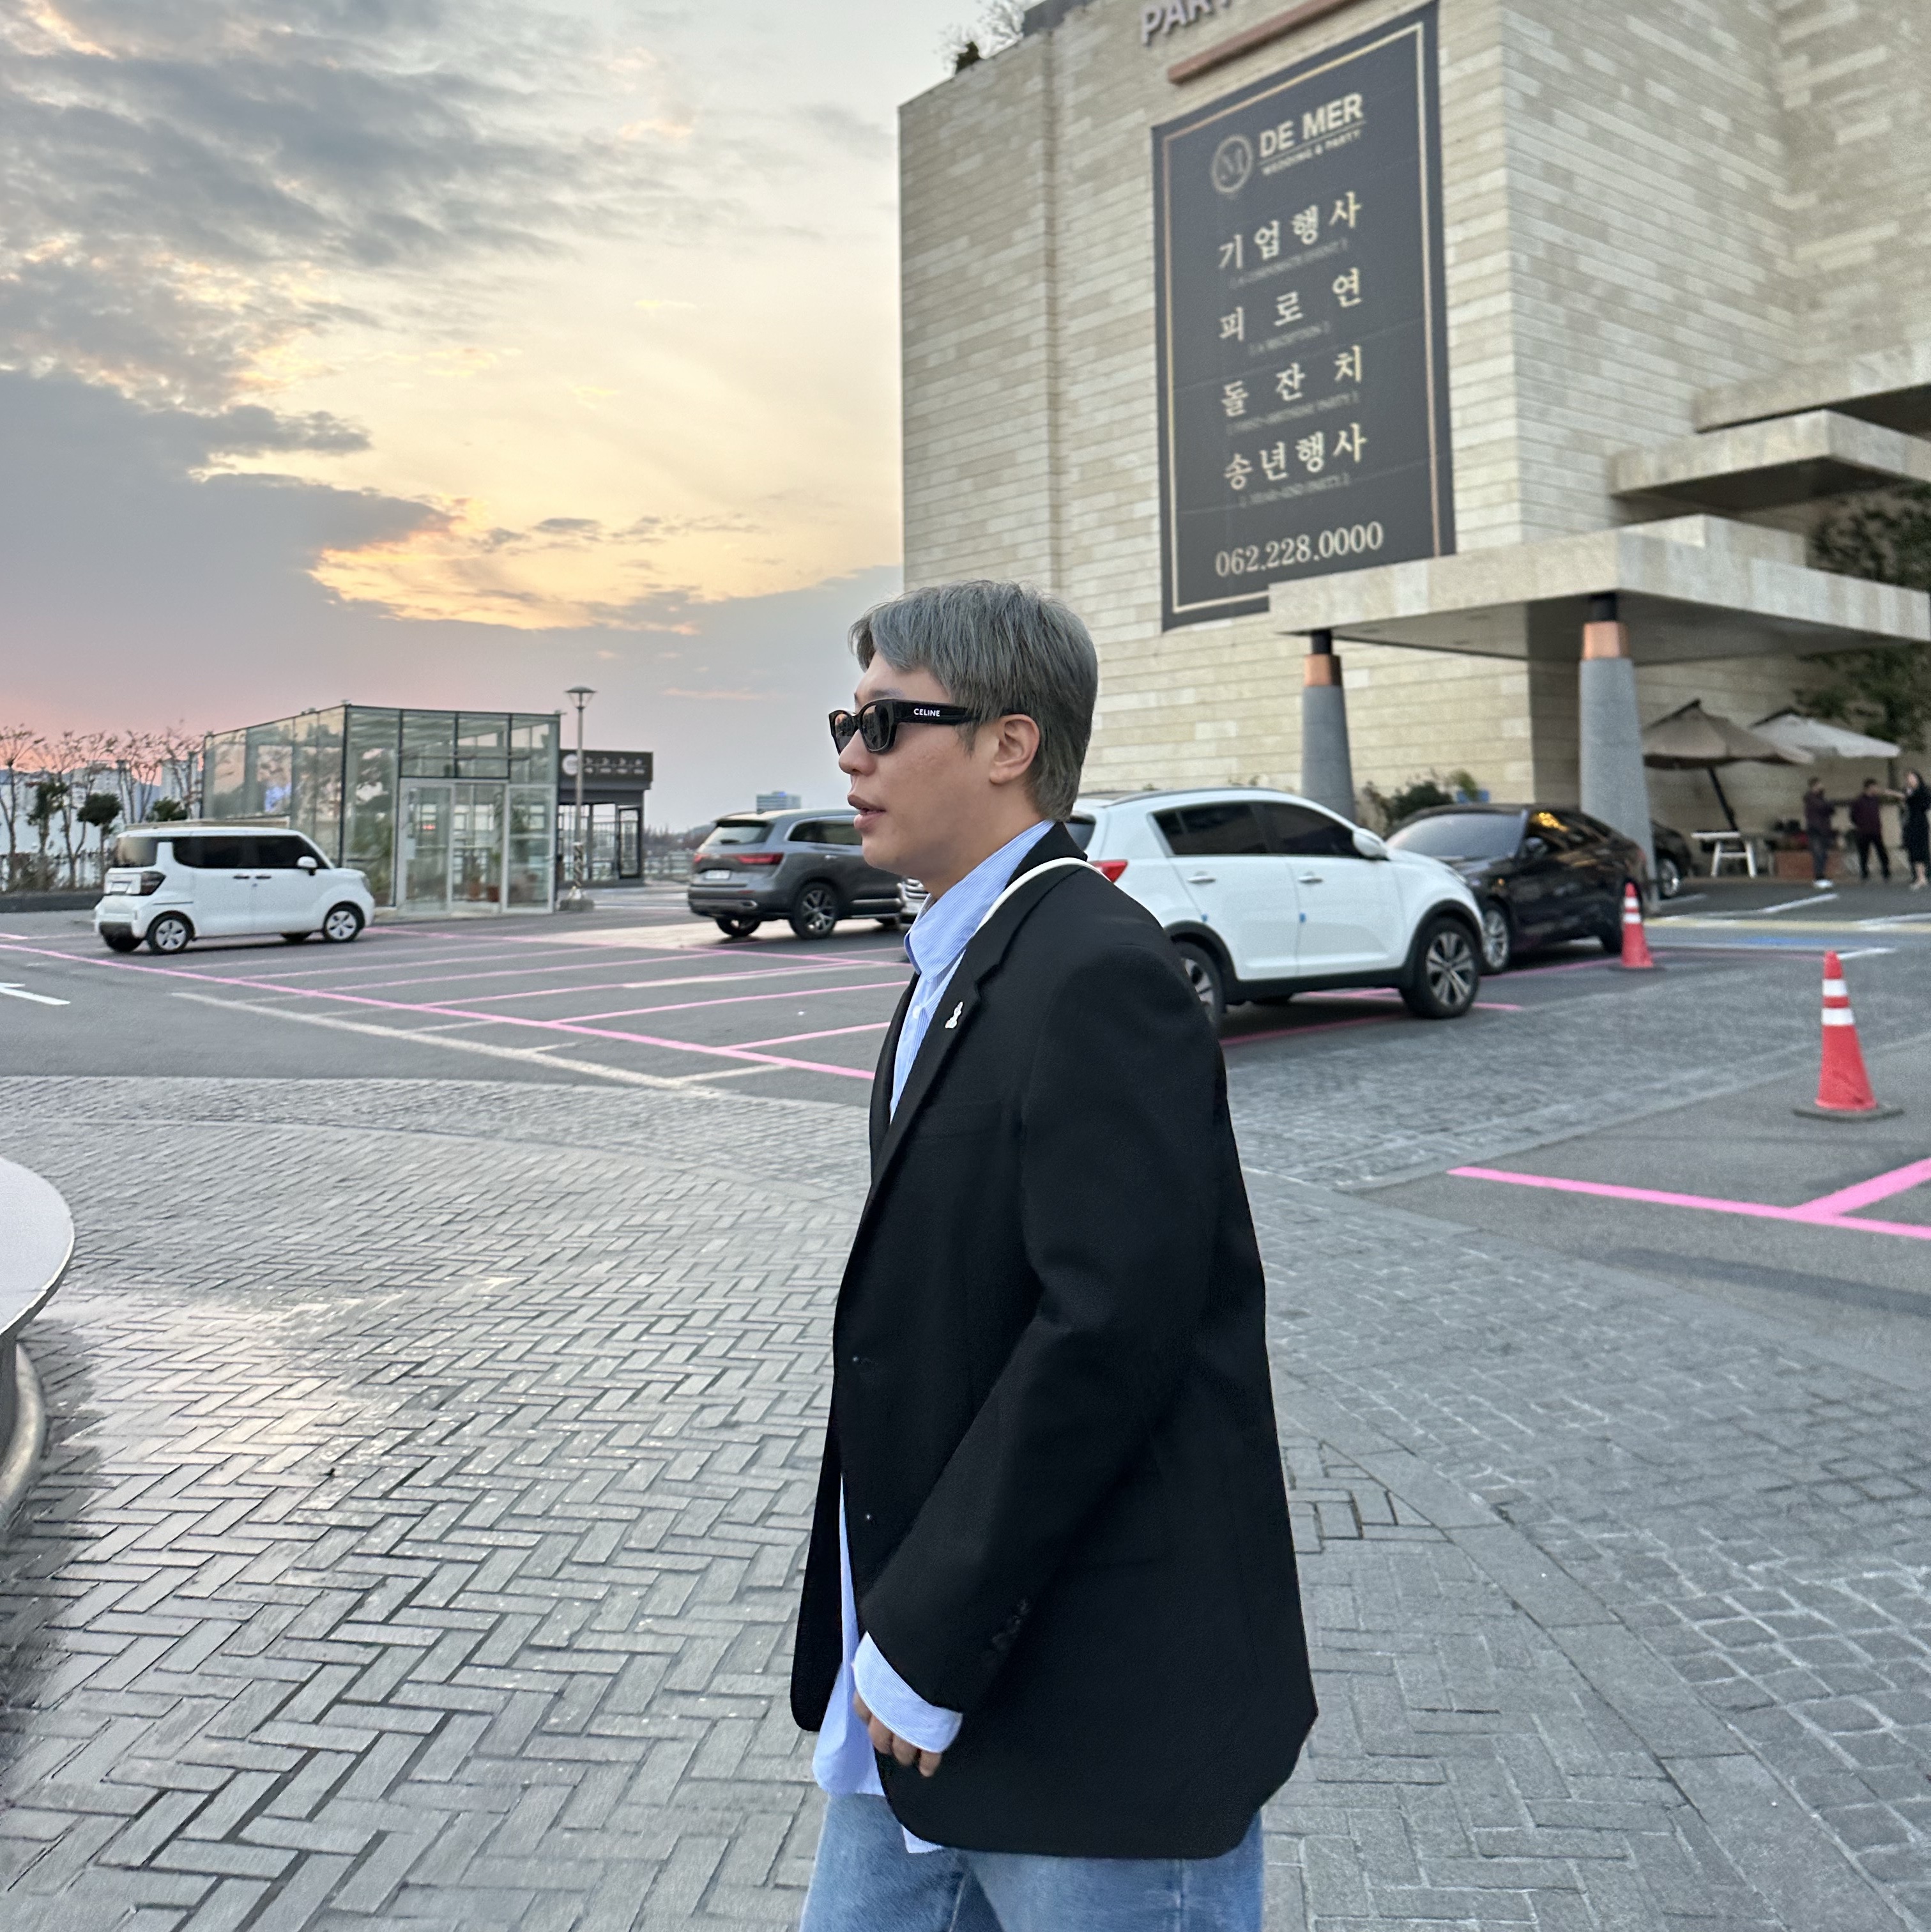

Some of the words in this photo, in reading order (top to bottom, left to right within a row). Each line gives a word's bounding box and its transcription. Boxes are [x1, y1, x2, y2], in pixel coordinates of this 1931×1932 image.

[1140, 0, 1232, 45] PAR
[1260, 120, 1295, 158] DE
[1302, 92, 1364, 140] MER
[1218, 191, 1362, 269] 기업행사
[1218, 266, 1362, 342] 피로연
[1221, 345, 1362, 418] 돌잔치
[1223, 422, 1368, 491] 송년행사
[1215, 521, 1384, 577] 062.228.0000
[913, 708, 941, 717] CELINE
